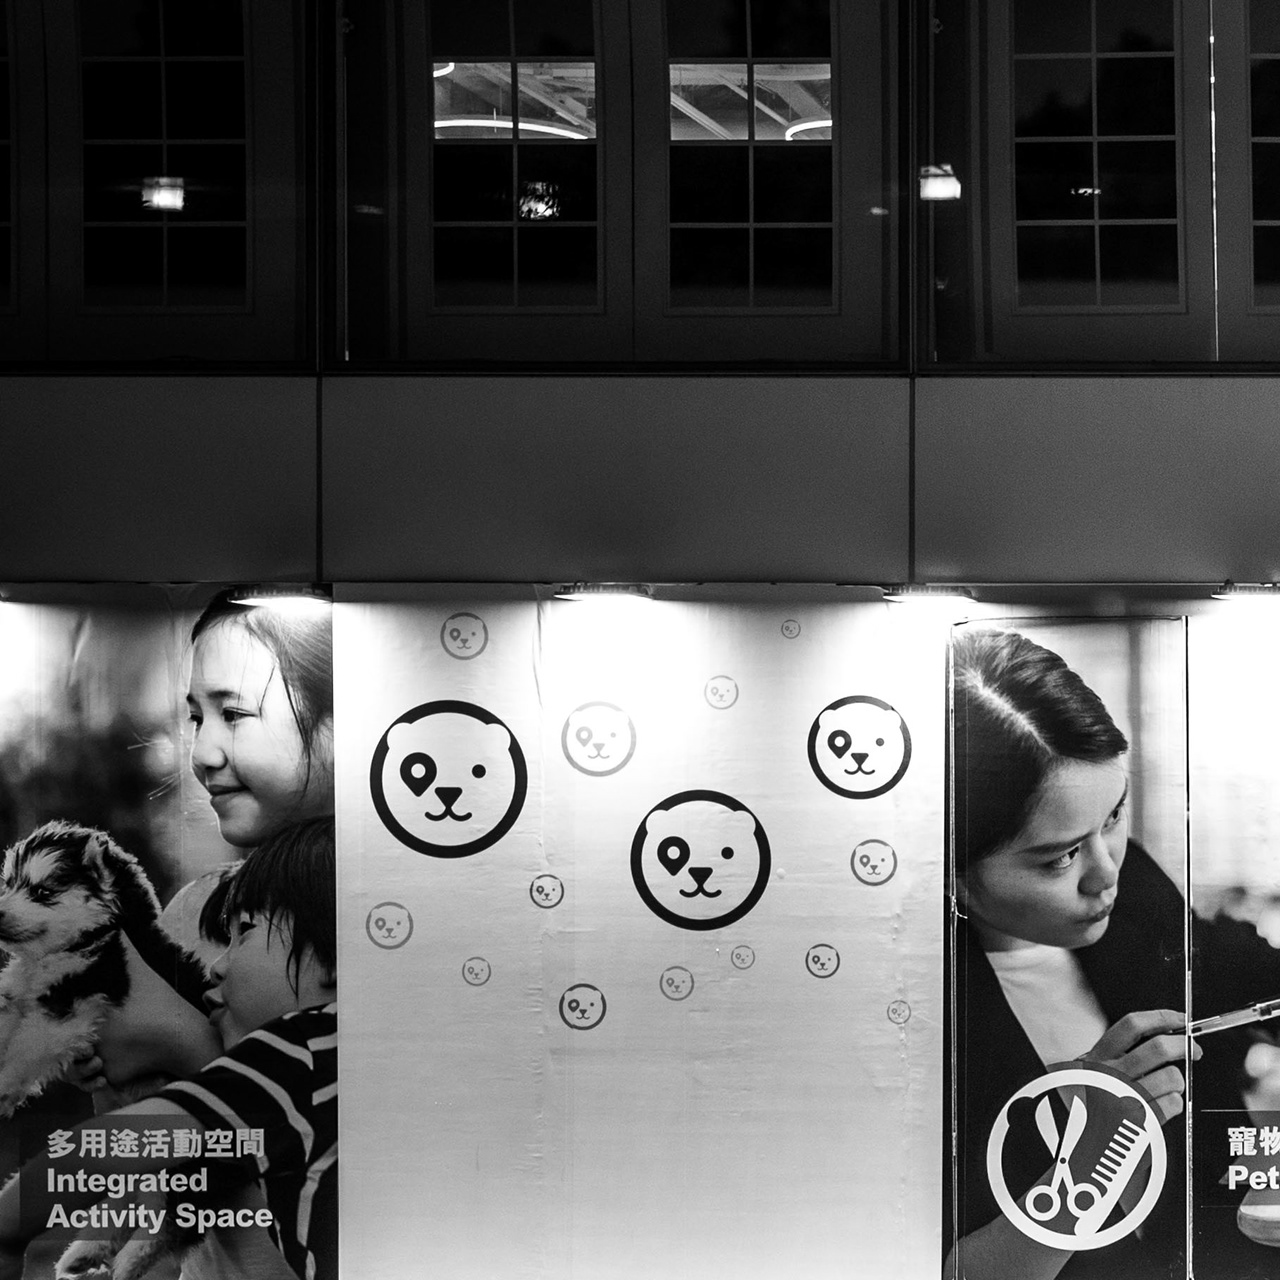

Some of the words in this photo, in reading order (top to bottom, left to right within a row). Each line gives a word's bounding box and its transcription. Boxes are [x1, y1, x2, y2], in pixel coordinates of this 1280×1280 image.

[47, 1128, 265, 1158] 多用途活動空間
[47, 1167, 208, 1198] Integrated
[1228, 1164, 1280, 1190] Pet
[46, 1202, 166, 1234] Activity
[175, 1202, 273, 1234] Space
